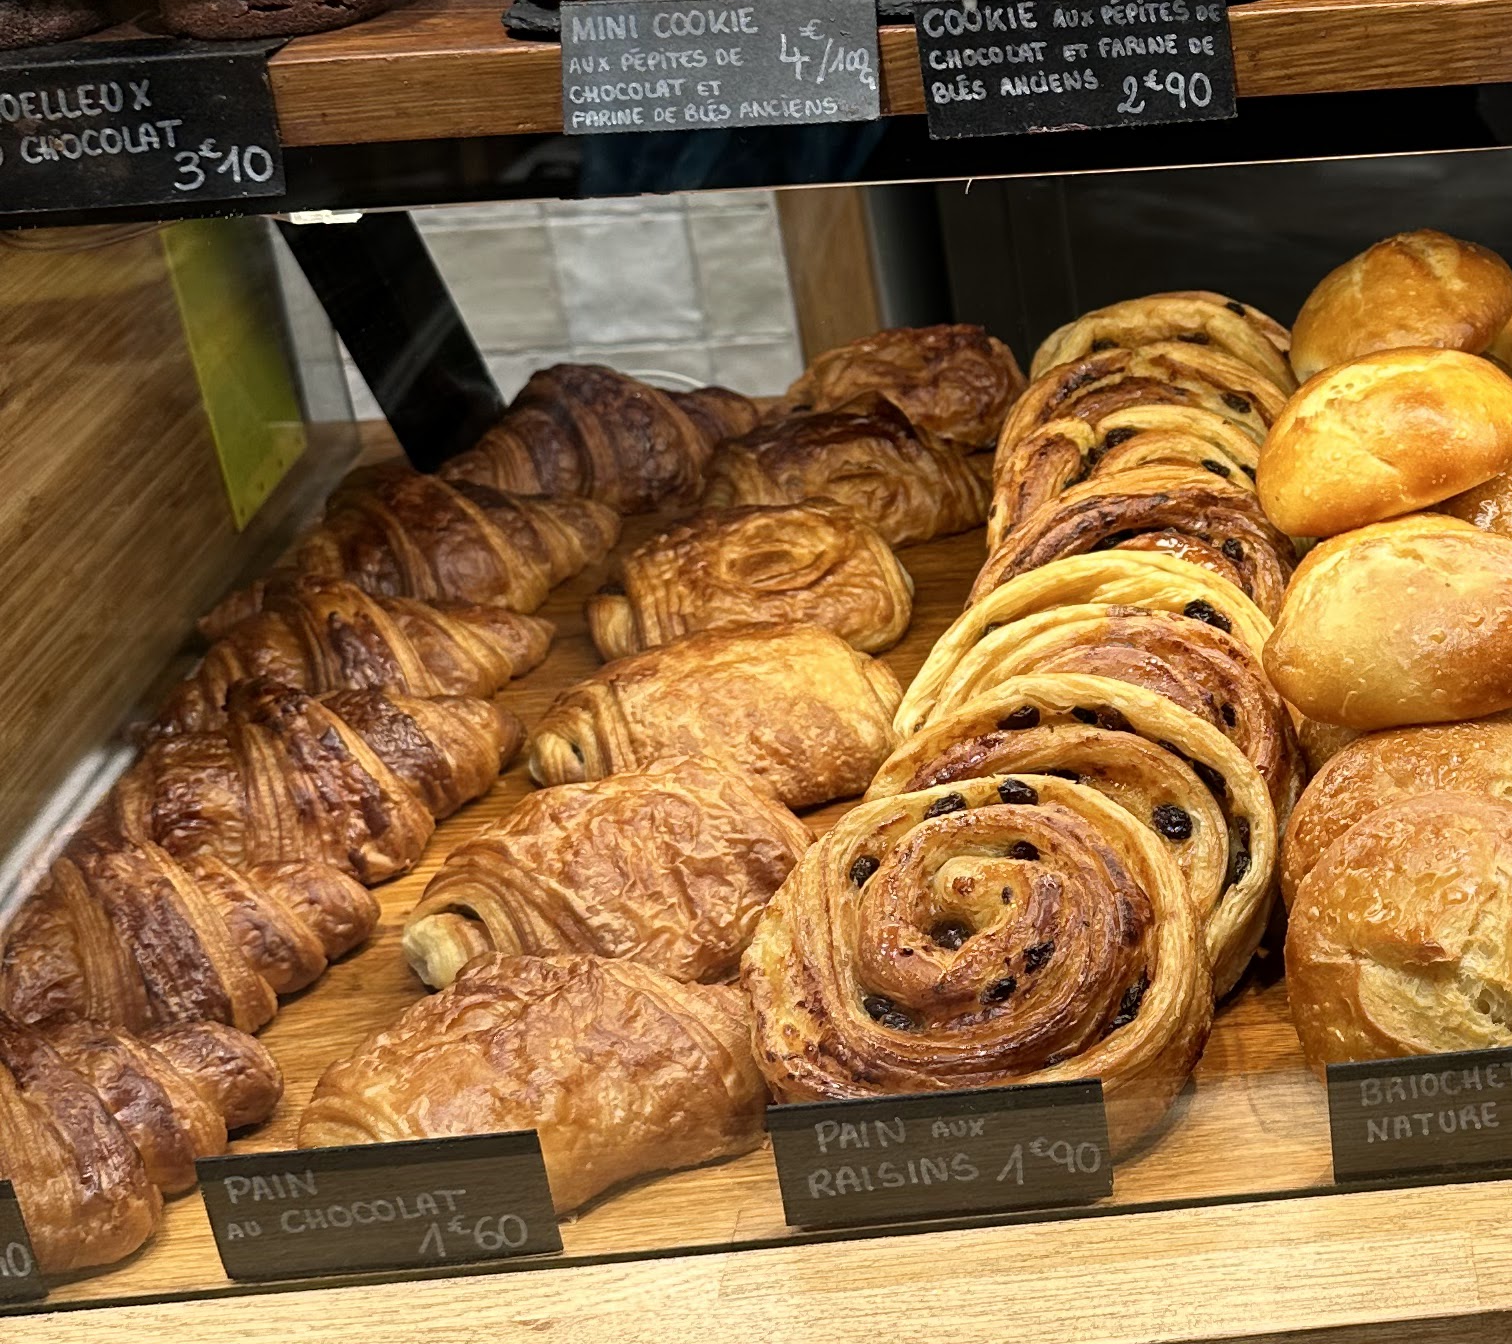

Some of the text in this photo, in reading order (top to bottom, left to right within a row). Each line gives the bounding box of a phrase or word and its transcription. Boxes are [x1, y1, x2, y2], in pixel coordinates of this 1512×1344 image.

[572, 7, 759, 45] MINI COOKIE
[922, 1, 1038, 38] COOKIE
[1053, 8, 1094, 28] AUX
[1195, 3, 1221, 23] DE
[569, 47, 744, 75] AUX PÉPITES DE
[929, 33, 1215, 71] CHOCOLAT ET FARINE DE
[569, 77, 722, 105] CHOCOLAT ET
[930, 67, 1212, 115] BLÉS ANCIENS 2€90
[571, 94, 838, 128] FARINE DE BLÉS ANCIENS
[20, 119, 183, 164] CHOCOLAT
[173, 138, 274, 191] 3€10
[814, 1116, 985, 1154] PAIN AUX
[1366, 1101, 1500, 1143] NATURE
[223, 1169, 319, 1204] PAIN
[807, 1137, 1101, 1200] RAISINS 1€90
[226, 1189, 467, 1241] AU CHOCOLAT
[417, 1213, 528, 1257] 1€60
